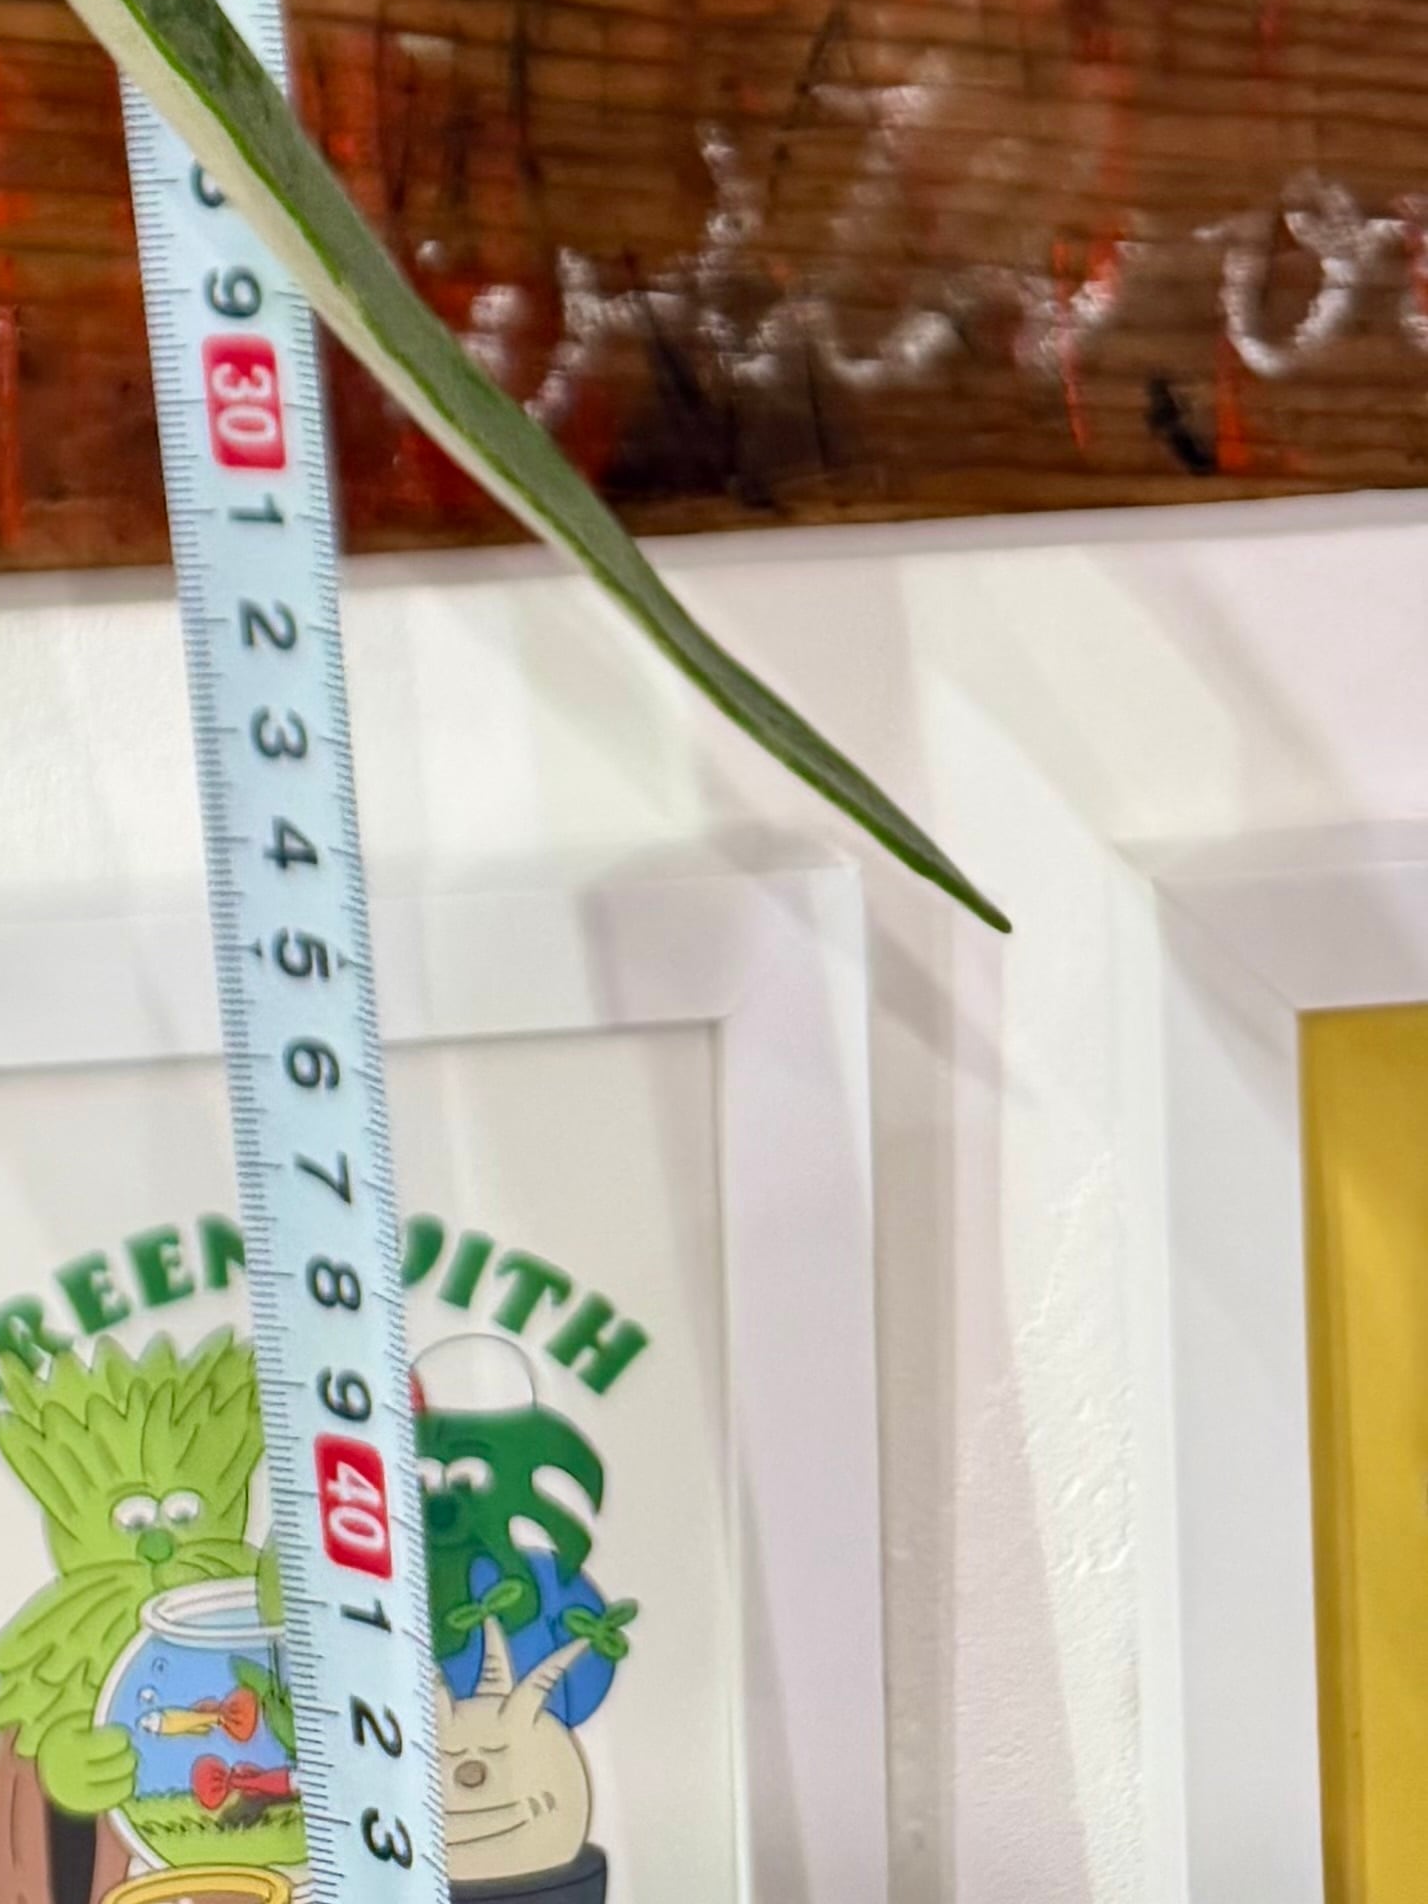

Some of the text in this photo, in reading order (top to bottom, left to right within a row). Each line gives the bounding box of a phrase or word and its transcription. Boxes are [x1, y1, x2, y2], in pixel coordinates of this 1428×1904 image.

[204, 265, 262, 319] 9
[210, 363, 278, 444] 30
[229, 494, 285, 527] 1
[239, 598, 298, 652] 2
[249, 706, 308, 761] 3
[263, 815, 320, 871] 4
[271, 926, 331, 984] 5
[281, 1036, 341, 1092] 6
[292, 1151, 353, 1206] 7
[305, 1254, 362, 1313] 8
[316, 1366, 373, 1425] 9
[325, 1459, 387, 1551] 40
[339, 1598, 393, 1636] 1
[350, 1695, 404, 1760] 2
[360, 1807, 413, 1870] 3
